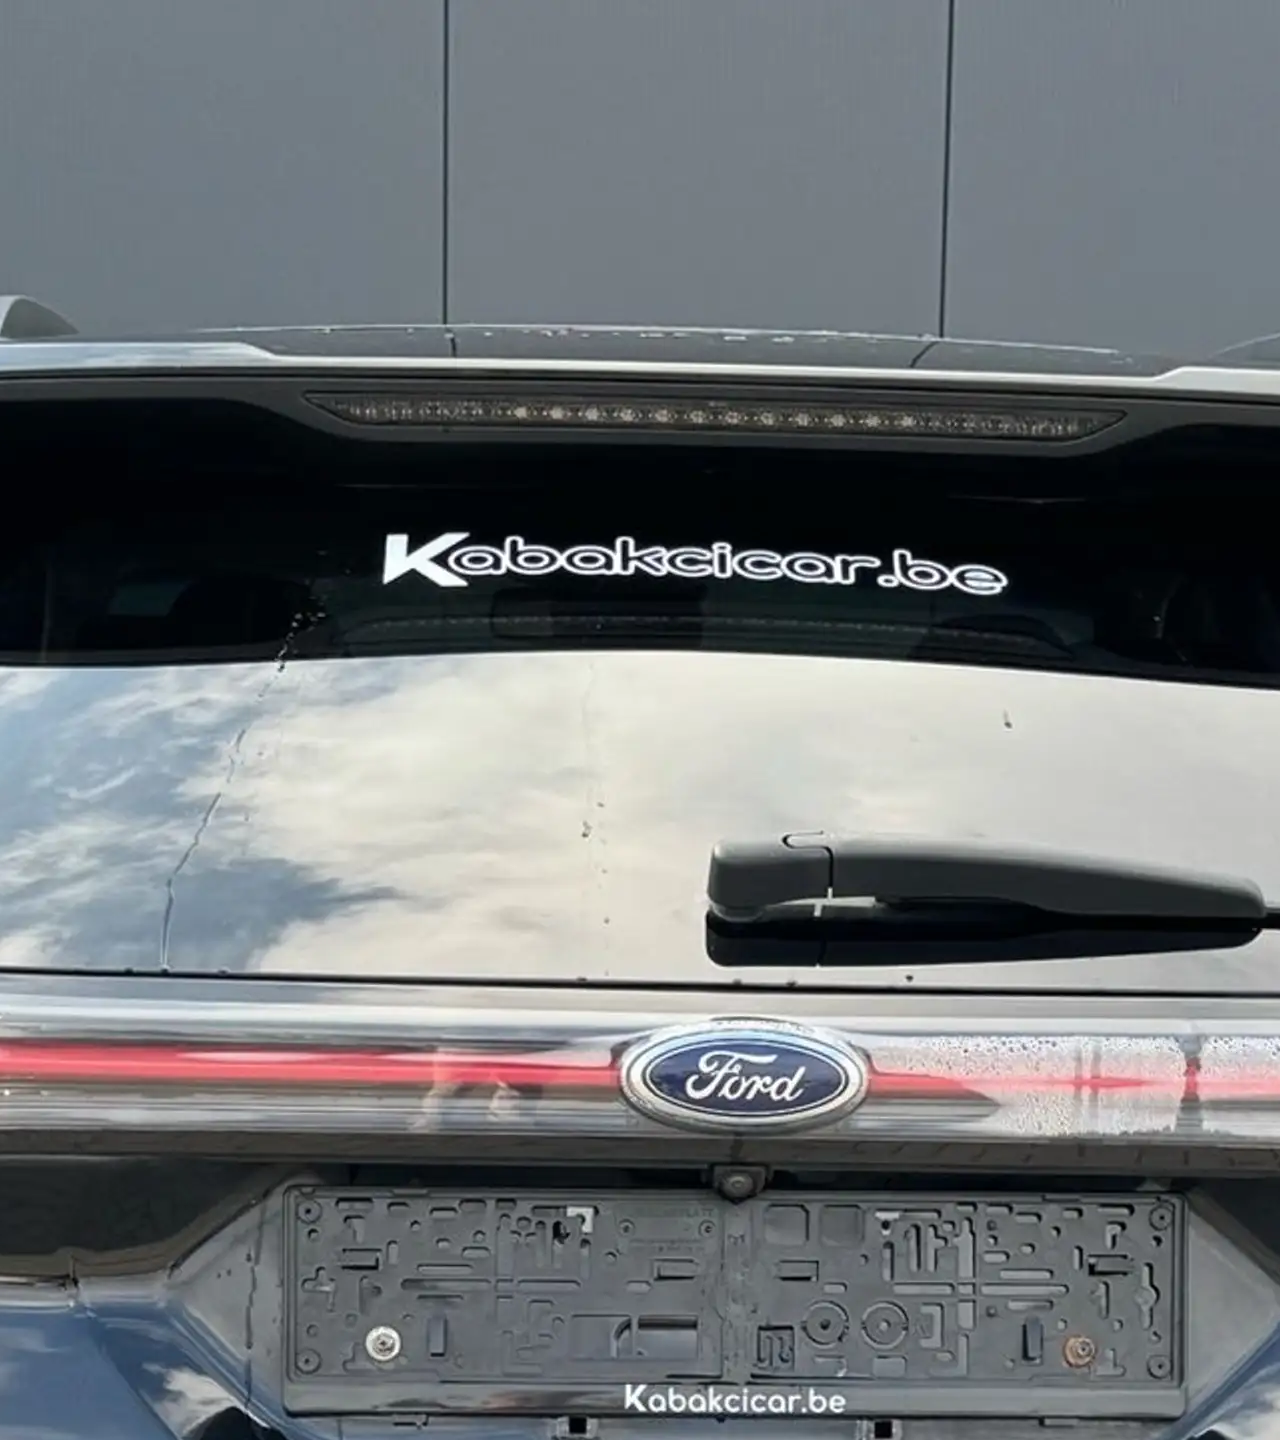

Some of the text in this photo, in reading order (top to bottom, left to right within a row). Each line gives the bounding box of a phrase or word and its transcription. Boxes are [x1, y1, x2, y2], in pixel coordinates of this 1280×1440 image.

[382, 531, 1009, 595] Kabakcicar.be
[685, 1050, 806, 1101] Ford
[623, 1384, 847, 1413] Kabakcicar.be
